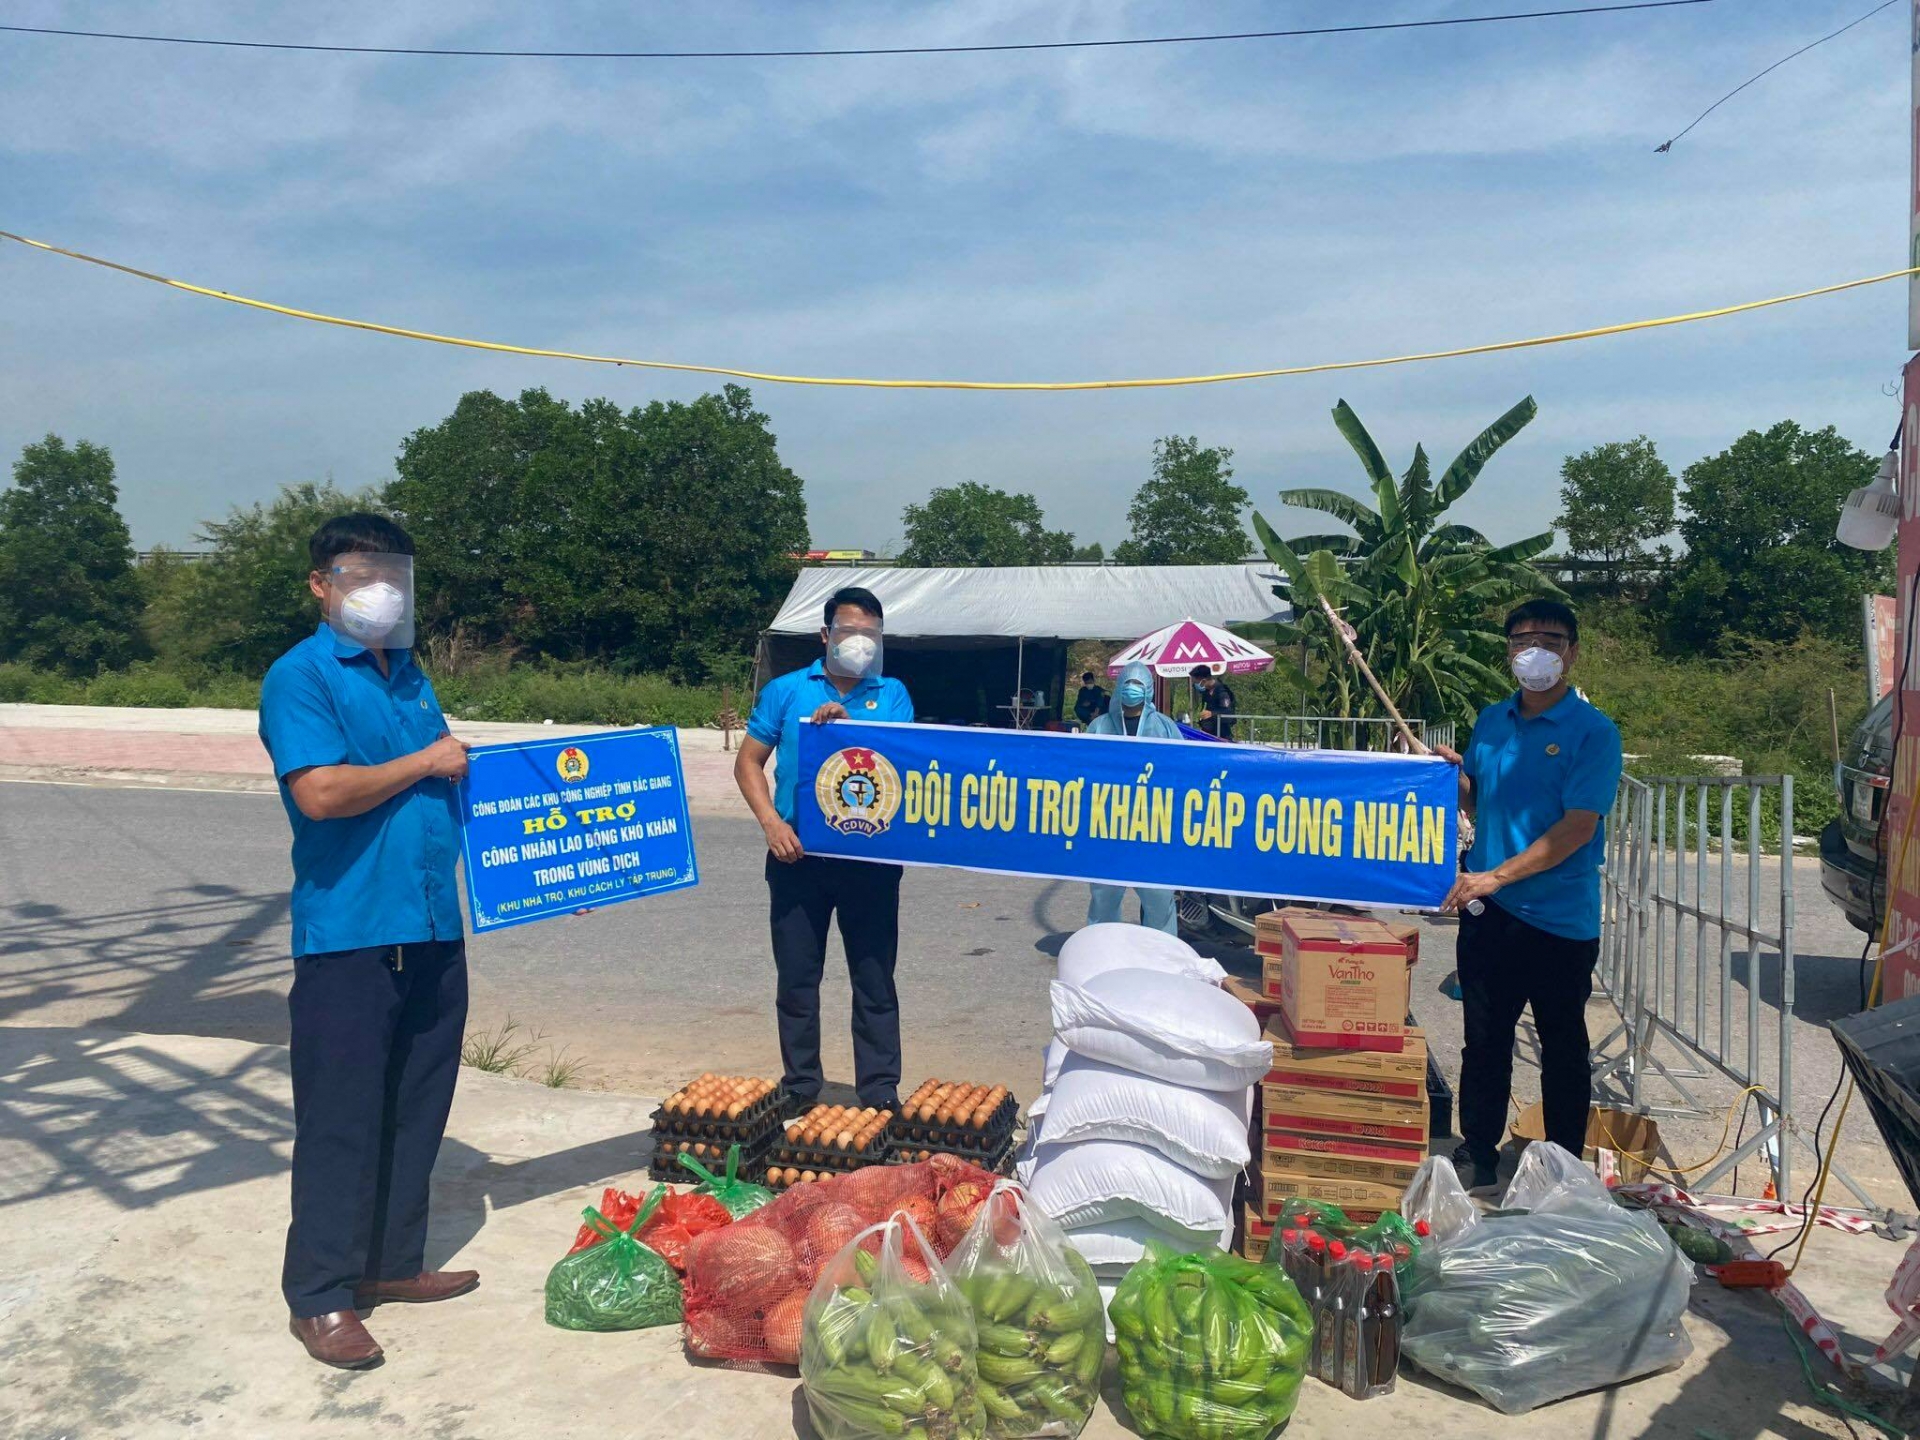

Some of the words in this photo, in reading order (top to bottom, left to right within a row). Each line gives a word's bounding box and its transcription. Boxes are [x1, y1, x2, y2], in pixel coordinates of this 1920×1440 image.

[472, 800, 498, 817] CÔNG
[498, 796, 522, 813] ĐOÀN
[523, 793, 541, 809] CÁC
[542, 792, 559, 806] KHU
[560, 787, 583, 803] CÔNG
[584, 782, 612, 800] NGHIỆP
[649, 775, 672, 790] GIANG
[522, 807, 567, 835] HỖ
[576, 800, 636, 825] TRỢ
[904, 759, 952, 838] ĐỘI
[960, 759, 1018, 832] CỨU
[1027, 777, 1085, 850] TRỢ
[1089, 762, 1174, 844] KHẨN
[1182, 770, 1245, 849] CẤP
[1255, 783, 1343, 858] CÔNG
[1352, 791, 1446, 865] NHÂN
[481, 846, 519, 868] CÔNG
[520, 837, 558, 861] NHÂN
[559, 834, 583, 854] LAO
[585, 828, 619, 851] ĐỘNG
[620, 820, 644, 843] KHÓ
[645, 816, 677, 838] KHĂN
[497, 899, 521, 915] (KHU
[522, 893, 543, 908] NHÀ
[567, 886, 587, 899] KHU
[588, 880, 613, 894] CÁCH
[615, 878, 625, 888] LY
[645, 866, 677, 882] TRUNG)
[533, 863, 575, 887] TRONG
[577, 857, 611, 878] VÙNG
[612, 851, 640, 873] DỊCH
